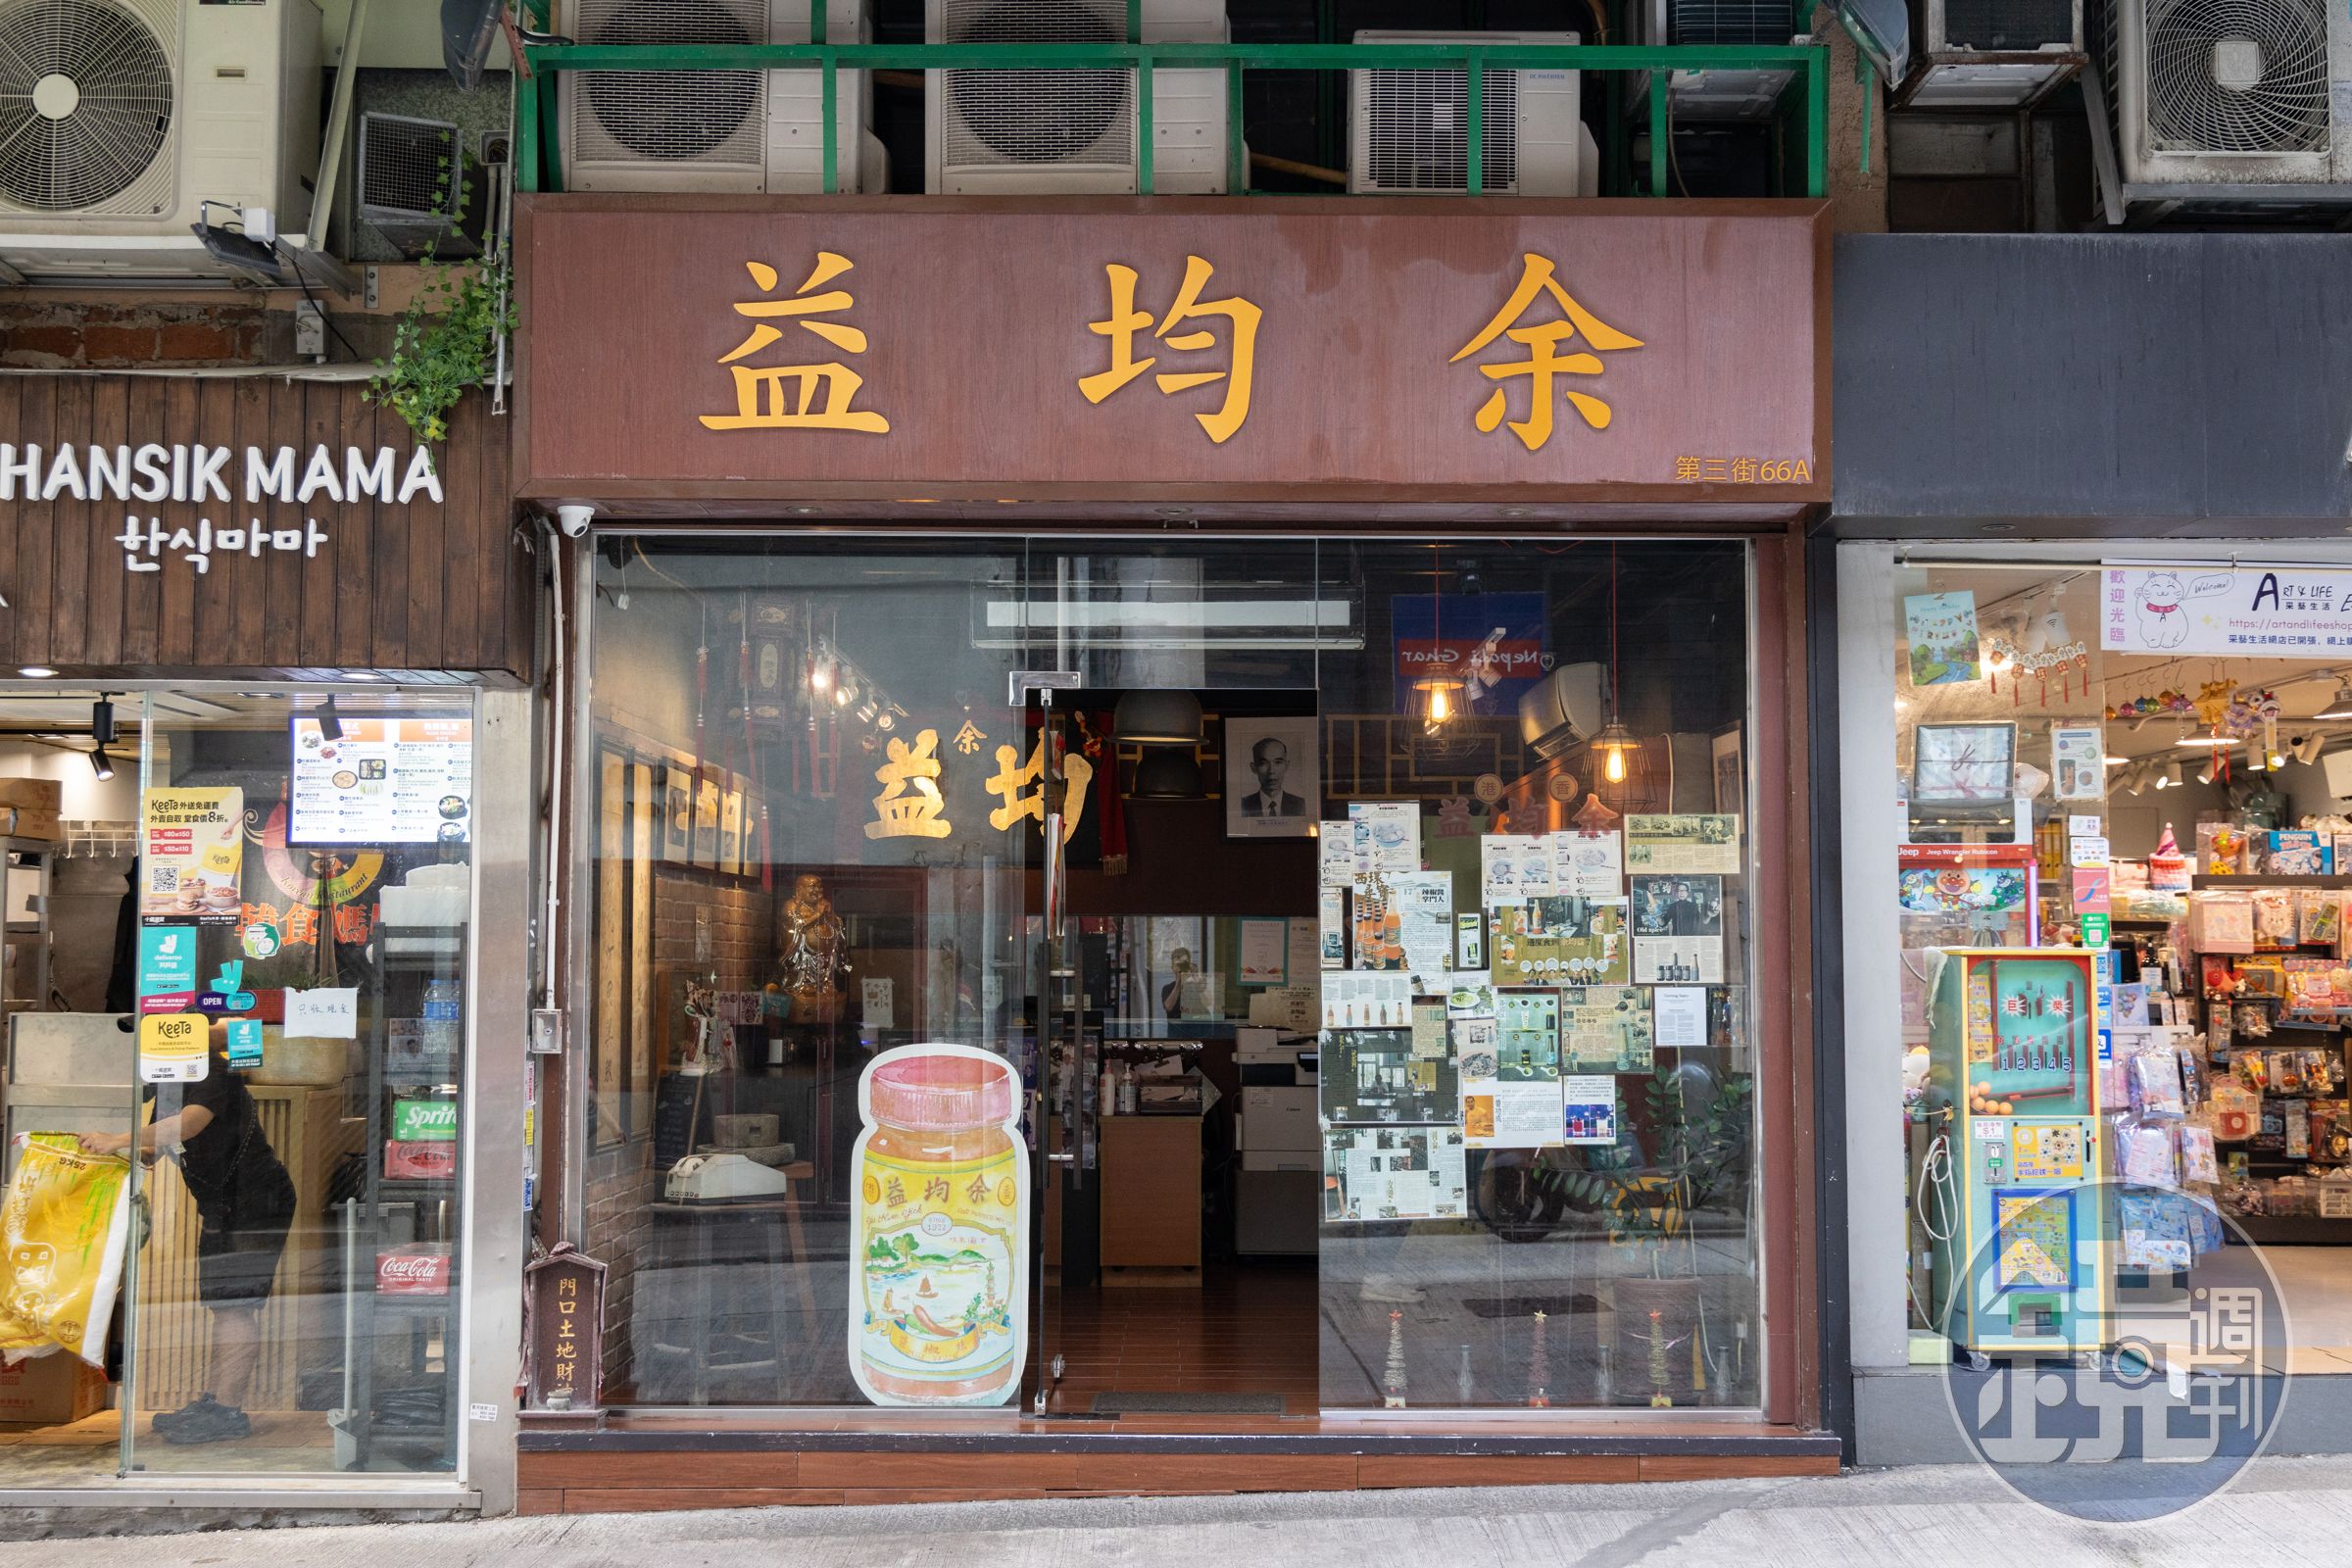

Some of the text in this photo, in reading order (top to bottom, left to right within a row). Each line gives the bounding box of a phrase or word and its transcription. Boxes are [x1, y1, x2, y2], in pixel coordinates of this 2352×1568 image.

[0, 443, 444, 505] HANSIK MAMA
[115, 514, 329, 574] 한식마마
[2109, 570, 2126, 642] 歡迎光臨
[151, 799, 178, 813] KeeTa
[203, 997, 222, 1005] OPEN
[158, 1020, 192, 1039] KeeTa
[2001, 1057, 2072, 1072] 1 2 3 4 5
[58, 1157, 86, 1172] 25KG
